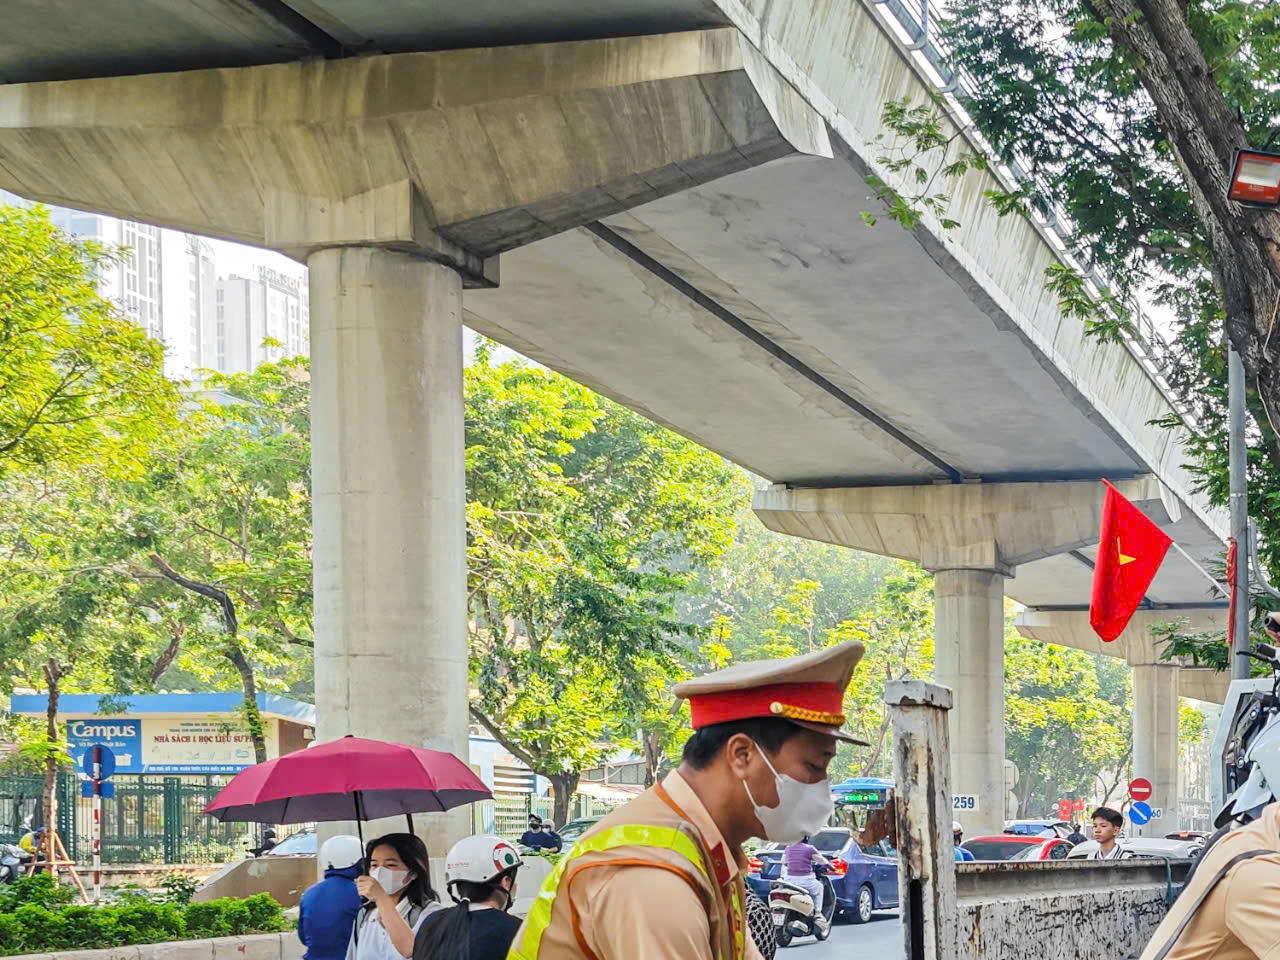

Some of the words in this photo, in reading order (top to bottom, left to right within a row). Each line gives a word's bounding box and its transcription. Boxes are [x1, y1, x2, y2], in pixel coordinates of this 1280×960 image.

[72, 720, 136, 740] Campus
[954, 796, 975, 808] 259
[1151, 809, 1161, 818] 60
